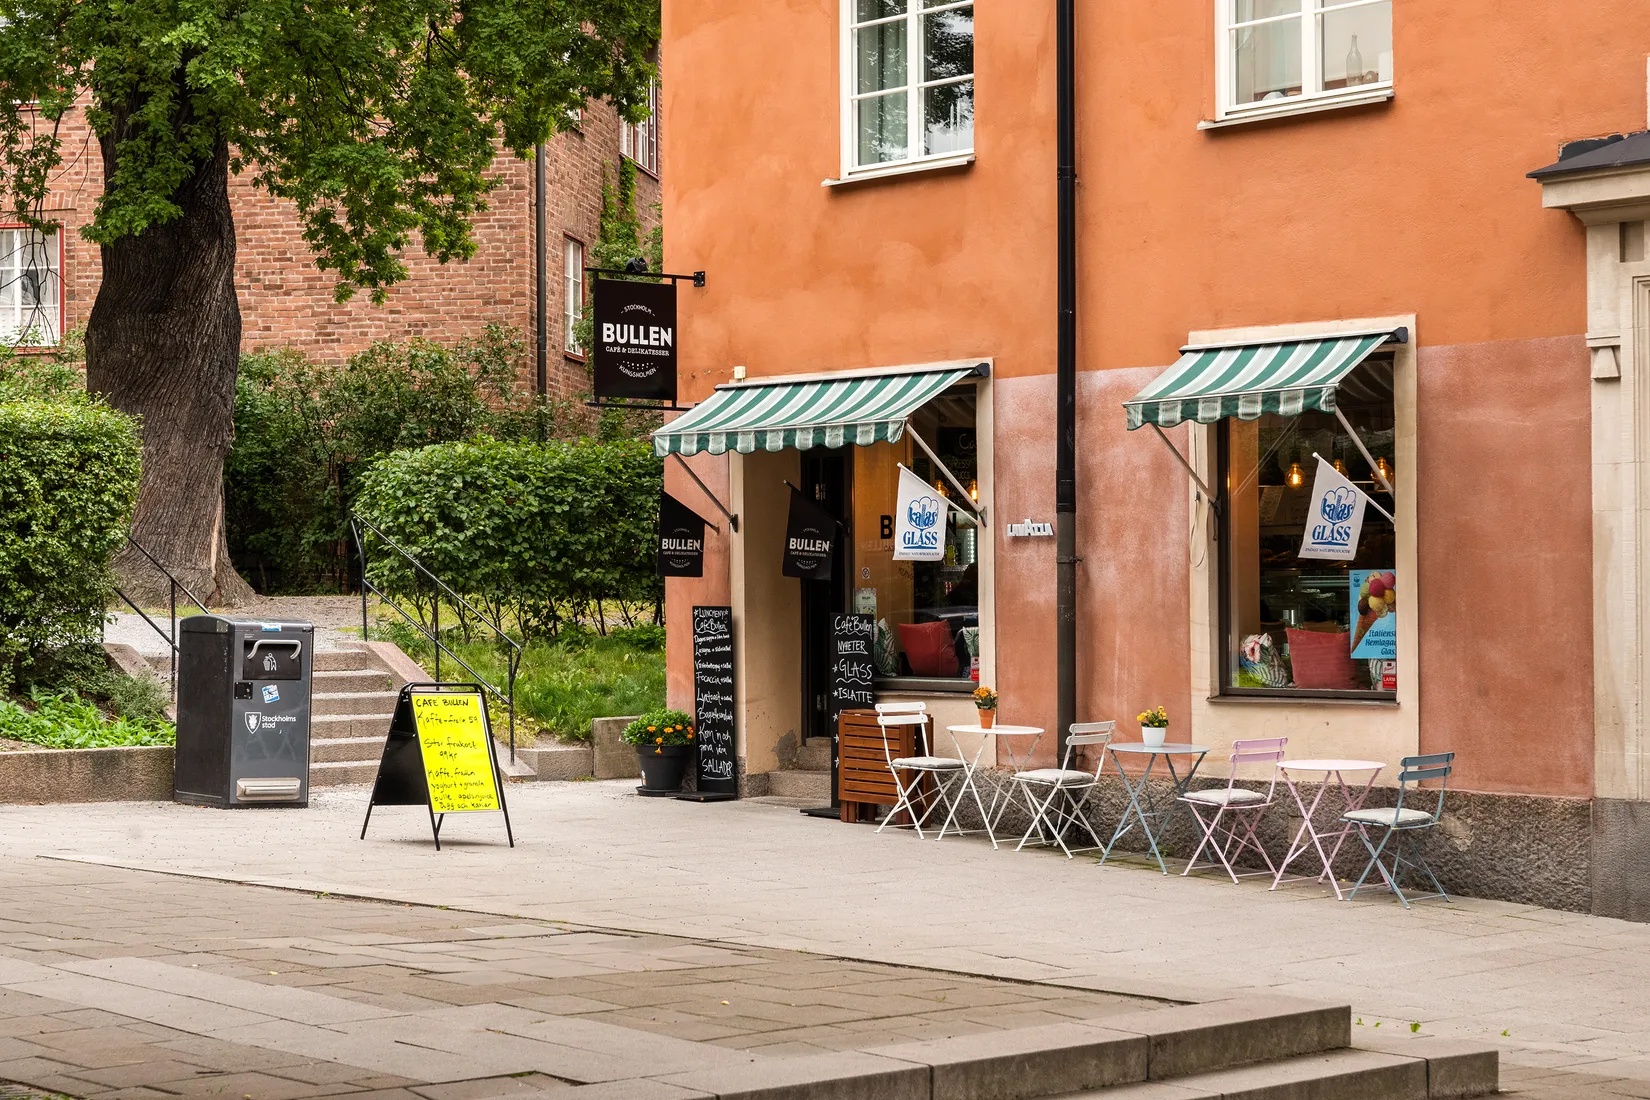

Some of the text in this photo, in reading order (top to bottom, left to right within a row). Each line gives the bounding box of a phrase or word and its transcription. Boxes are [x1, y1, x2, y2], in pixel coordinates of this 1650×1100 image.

[623, 304, 652, 314] STOCKHOLM
[602, 322, 672, 347] BULLEN
[618, 364, 657, 378] KUNGSHOLMEN
[902, 530, 938, 546] GLASS
[1312, 524, 1351, 541] GLASS
[661, 538, 701, 551] BULLEN
[789, 537, 830, 552] BULLEN
[834, 615, 873, 636] Café Bullen
[837, 640, 866, 652] NYHETER
[839, 658, 873, 680] GLASS
[442, 698, 469, 707] BULLEN
[838, 687, 873, 704] ISLATTE
